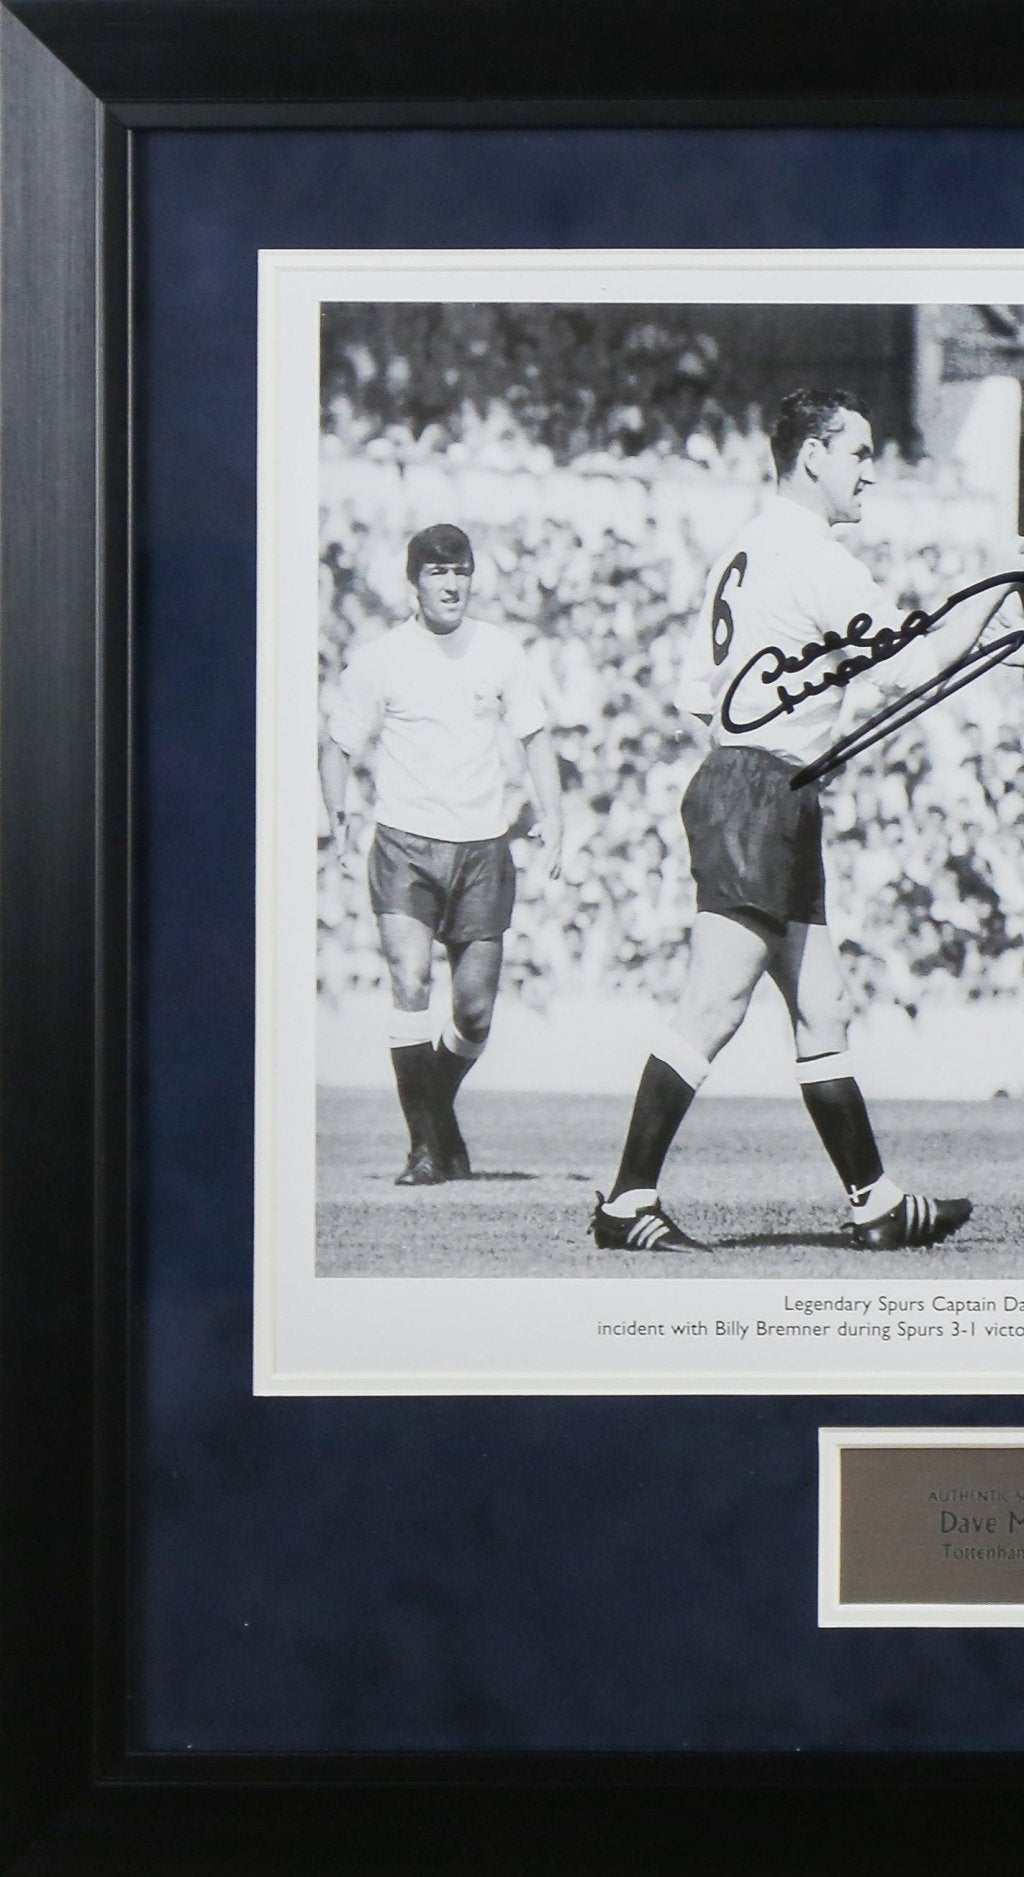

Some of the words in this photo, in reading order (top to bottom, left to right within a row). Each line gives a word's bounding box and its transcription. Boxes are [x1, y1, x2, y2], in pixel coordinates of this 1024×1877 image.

[712, 551, 748, 666] 6
[785, 1296, 872, 1315] Legendary
[878, 1296, 924, 1315] Spurs
[932, 1296, 996, 1316] Captain
[598, 1321, 665, 1335] incident
[671, 1321, 708, 1335] with
[716, 1320, 749, 1340] Billy
[757, 1321, 831, 1336] Bremner
[837, 1321, 891, 1341] during
[897, 1321, 944, 1341] Spurs
[951, 1321, 975, 1336] 3-1
[939, 1511, 997, 1534] Dave
